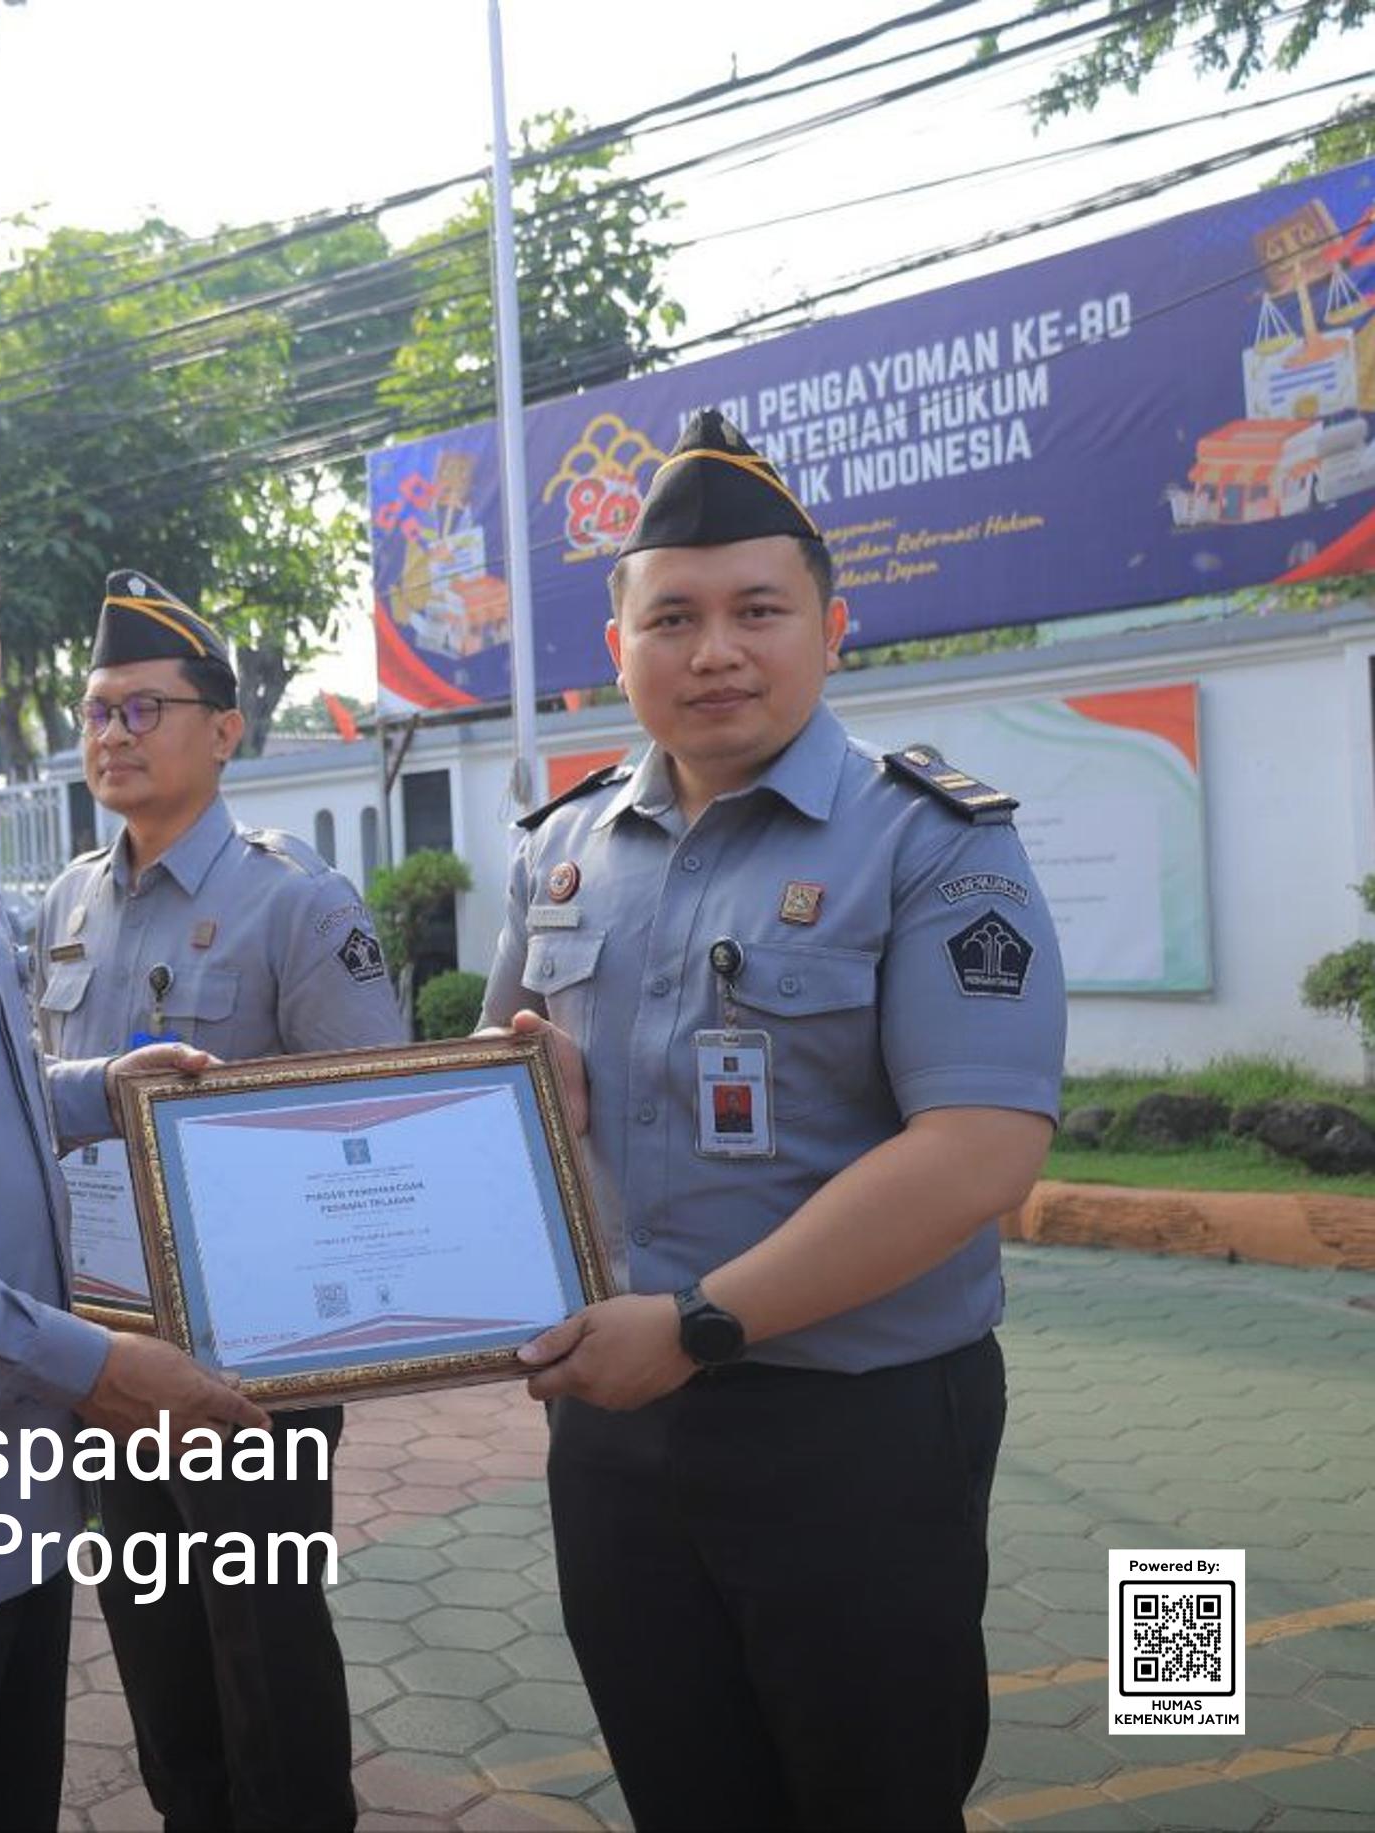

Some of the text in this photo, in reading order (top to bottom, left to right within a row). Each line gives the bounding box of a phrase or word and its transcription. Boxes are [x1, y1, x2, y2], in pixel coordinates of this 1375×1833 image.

[759, 326, 998, 429] PENGAYOMAN
[1012, 292, 1131, 365] KE-80
[919, 364, 1048, 435] HUKUM
[842, 417, 1032, 498] INDONESIA
